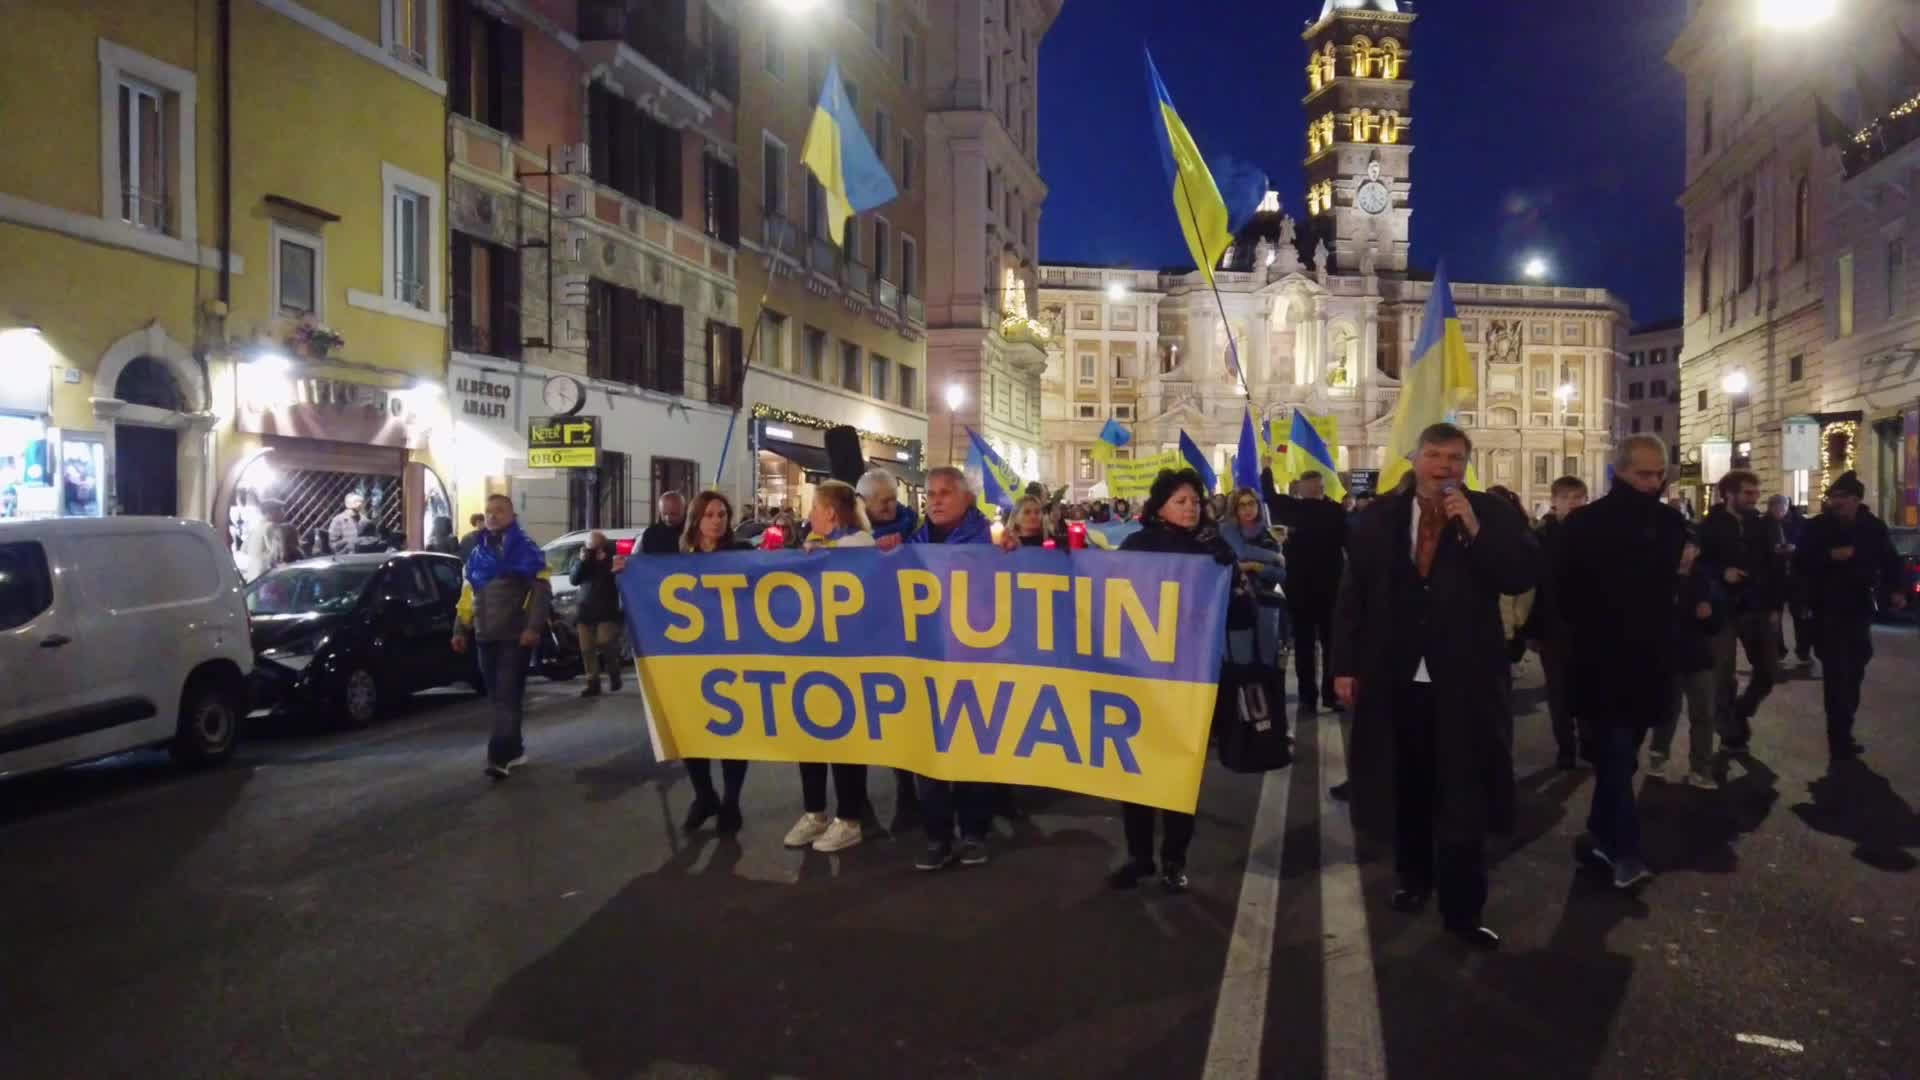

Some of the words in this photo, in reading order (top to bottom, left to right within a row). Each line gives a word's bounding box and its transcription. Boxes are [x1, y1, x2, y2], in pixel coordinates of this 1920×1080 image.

[455, 377, 511, 399] ALBERGO
[463, 400, 505, 418] AMALFI
[531, 453, 562, 464] ORO
[658, 571, 865, 643] STOP
[897, 569, 1180, 664] PUTIN
[701, 668, 907, 741] STOP
[925, 676, 1143, 776] WAR
